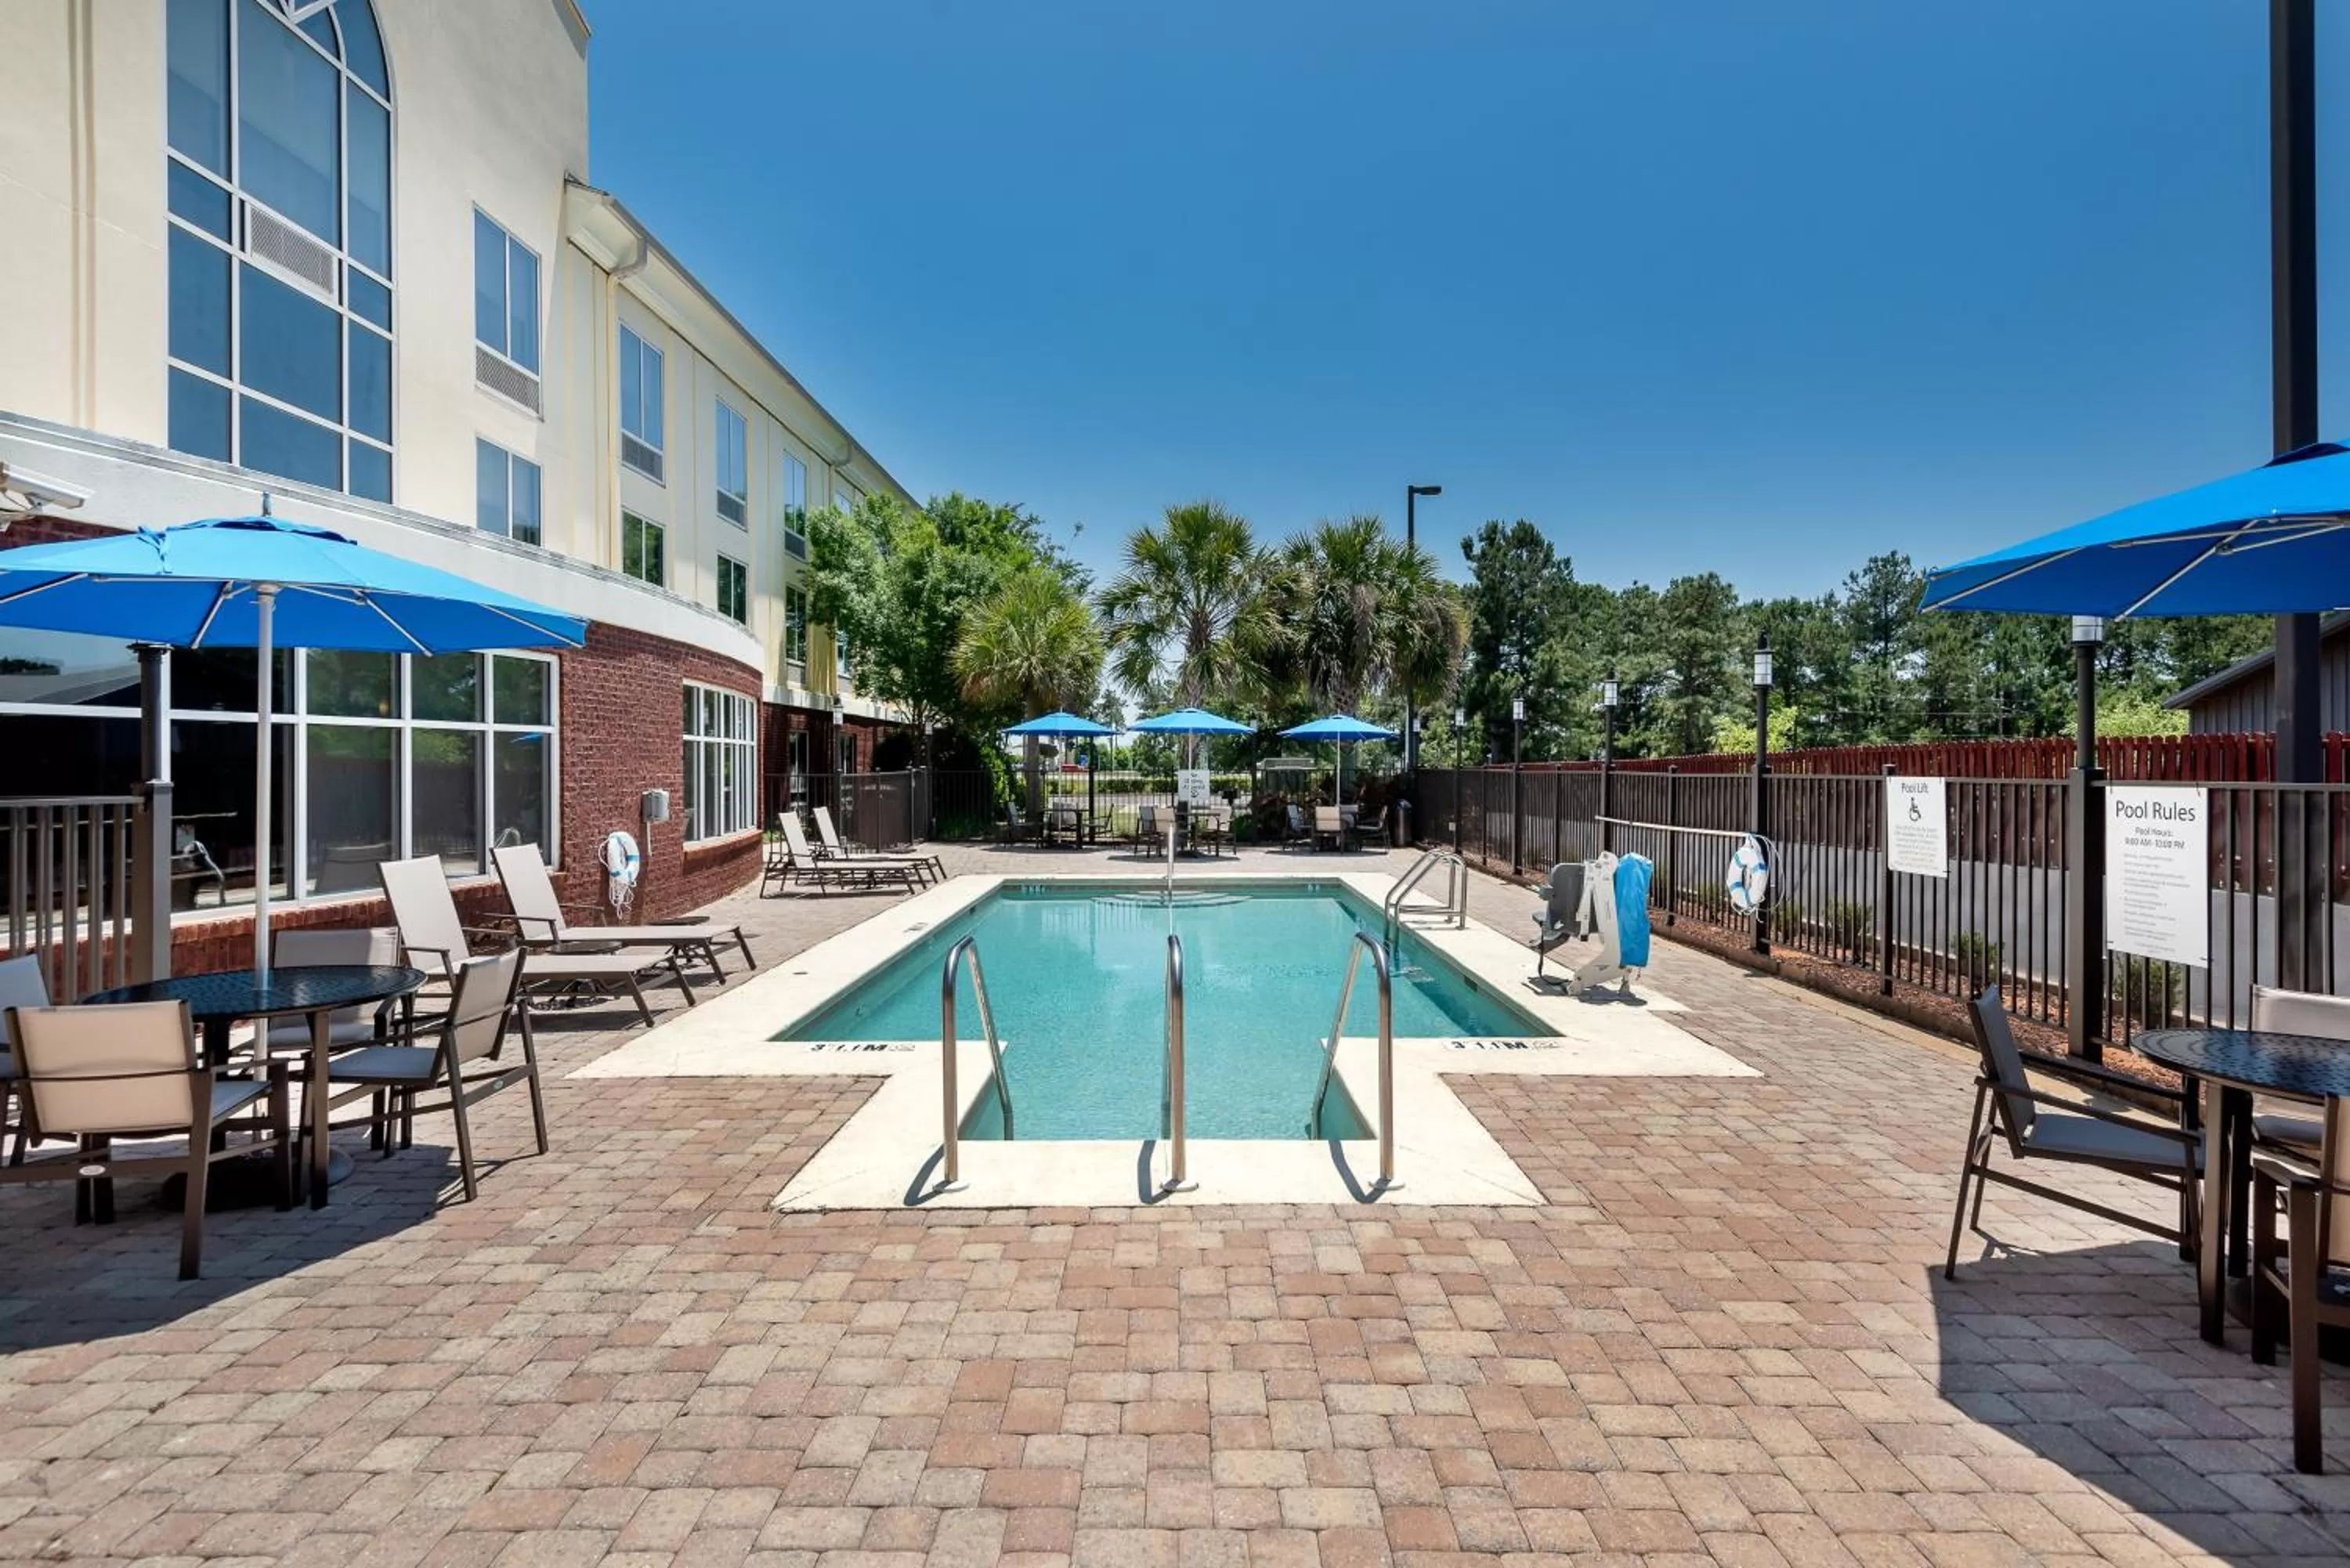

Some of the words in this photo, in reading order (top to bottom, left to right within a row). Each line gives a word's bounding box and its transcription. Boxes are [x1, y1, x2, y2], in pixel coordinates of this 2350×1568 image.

[1901, 782, 1916, 793] Pool
[1917, 782, 1929, 793] Lift
[2116, 800, 2147, 818] Pool
[2152, 801, 2196, 822] Rules
[2135, 826, 2149, 836] Pool
[2174, 840, 2185, 849] PM
